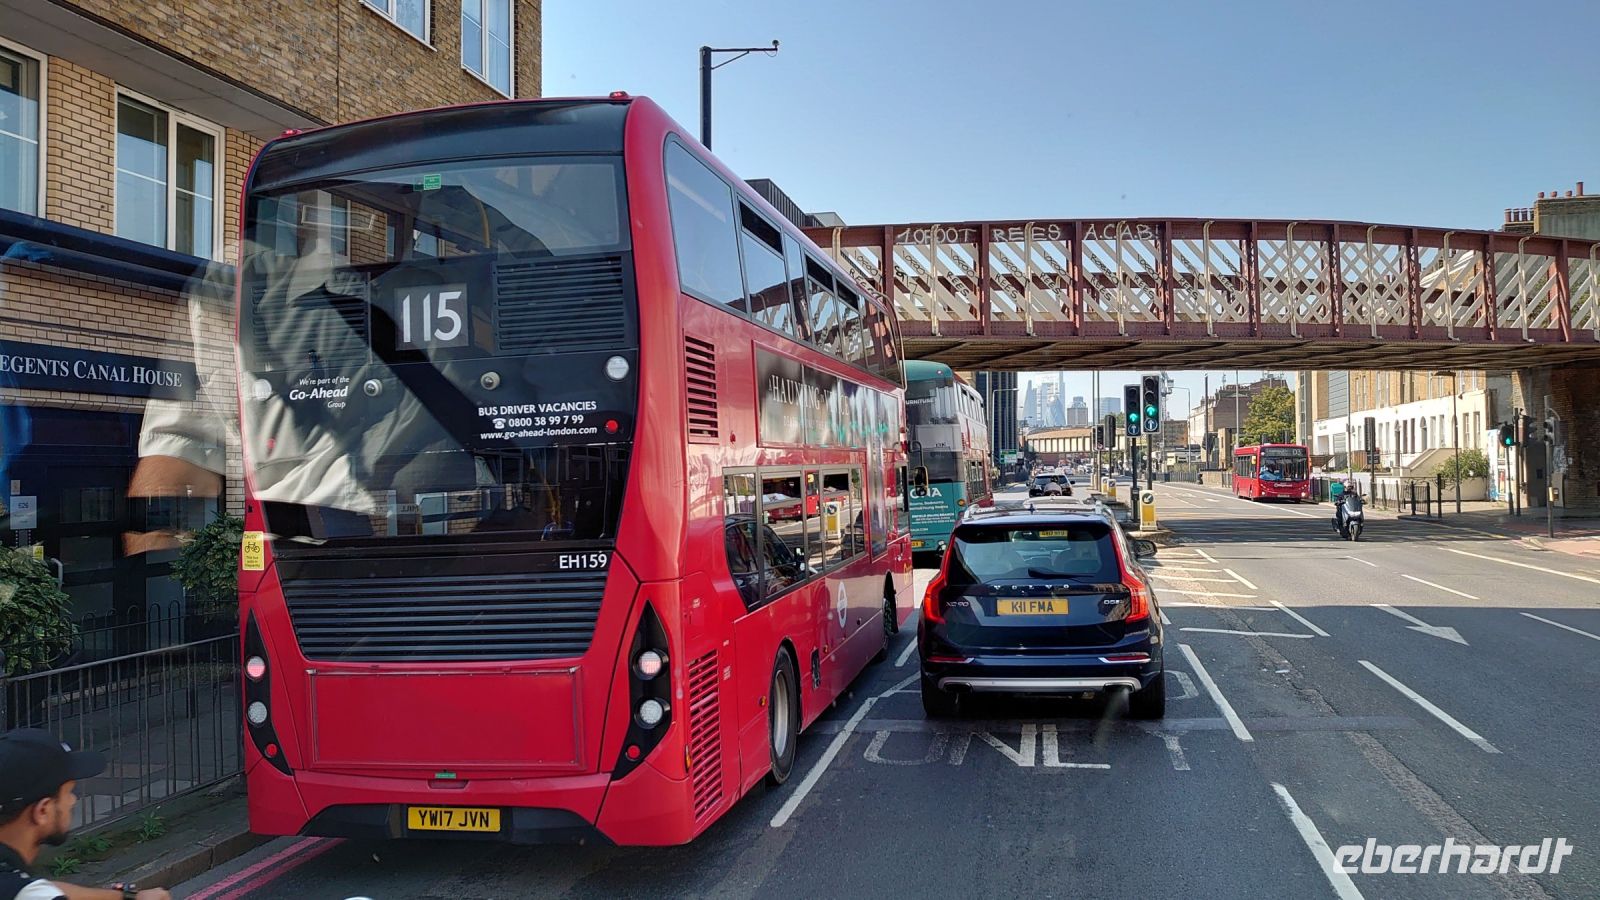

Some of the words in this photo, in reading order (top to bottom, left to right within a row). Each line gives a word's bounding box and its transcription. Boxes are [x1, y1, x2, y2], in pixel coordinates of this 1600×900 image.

[992, 224, 1061, 242] REES
[402, 291, 462, 342] 115
[317, 378, 330, 386] part
[332, 376, 340, 385] of
[340, 375, 350, 383] the
[289, 385, 349, 401] Go-Ahead
[327, 401, 346, 409] Group
[478, 406, 498, 417] BUS
[500, 404, 536, 415] DRIVER
[538, 401, 597, 413] VACANCIES
[508, 417, 532, 428] 0800
[534, 416, 546, 426] 38
[549, 415, 560, 425] 99
[563, 415, 569, 424] 7
[571, 414, 584, 424] 99
[480, 426, 597, 440] www.go-ahead-london.com
[559, 554, 607, 568] EH159
[1029, 601, 1054, 613] FMA
[418, 810, 453, 826] YW17
[458, 811, 490, 828] JVN
